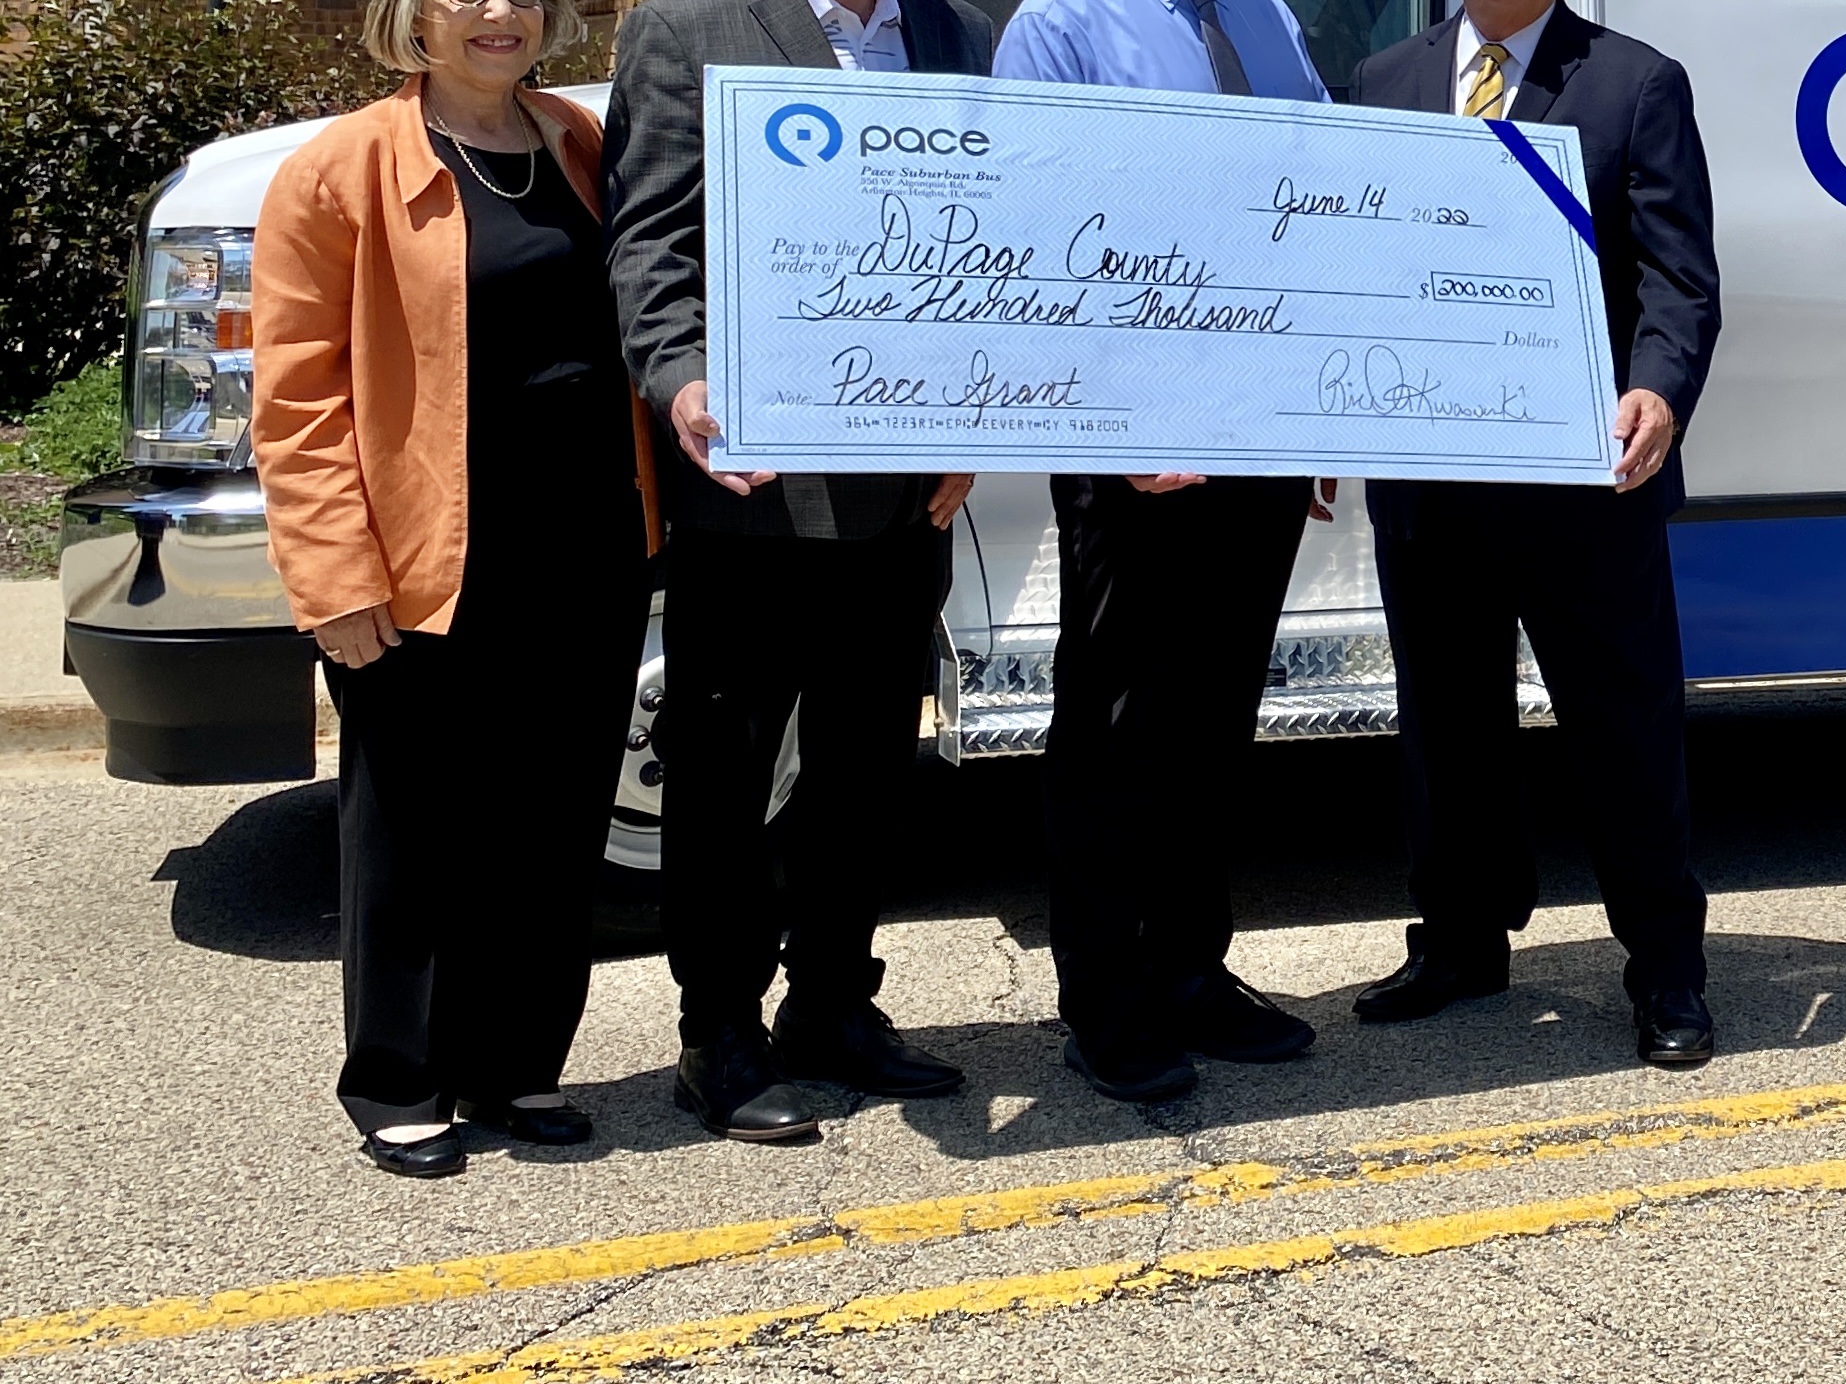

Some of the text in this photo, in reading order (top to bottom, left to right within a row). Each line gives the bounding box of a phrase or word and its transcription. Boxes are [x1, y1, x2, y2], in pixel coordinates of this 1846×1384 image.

[860, 125, 991, 157] pace
[860, 177, 878, 185] 550
[897, 178, 946, 189] Algonquin
[861, 166, 1001, 182] Pace Suburban Bus
[950, 190, 961, 198] IL
[963, 191, 992, 199] 60005
[1272, 176, 1350, 242] June
[1357, 183, 1387, 218] 14
[771, 238, 859, 259] Pay to the
[857, 193, 1216, 306] DuPage County
[771, 257, 843, 279] order of
[799, 275, 1292, 333] Two Hundred Thousand
[1502, 331, 1560, 349] Dollars
[832, 345, 1083, 427] Pace Grant
[770, 390, 813, 406] Note:
